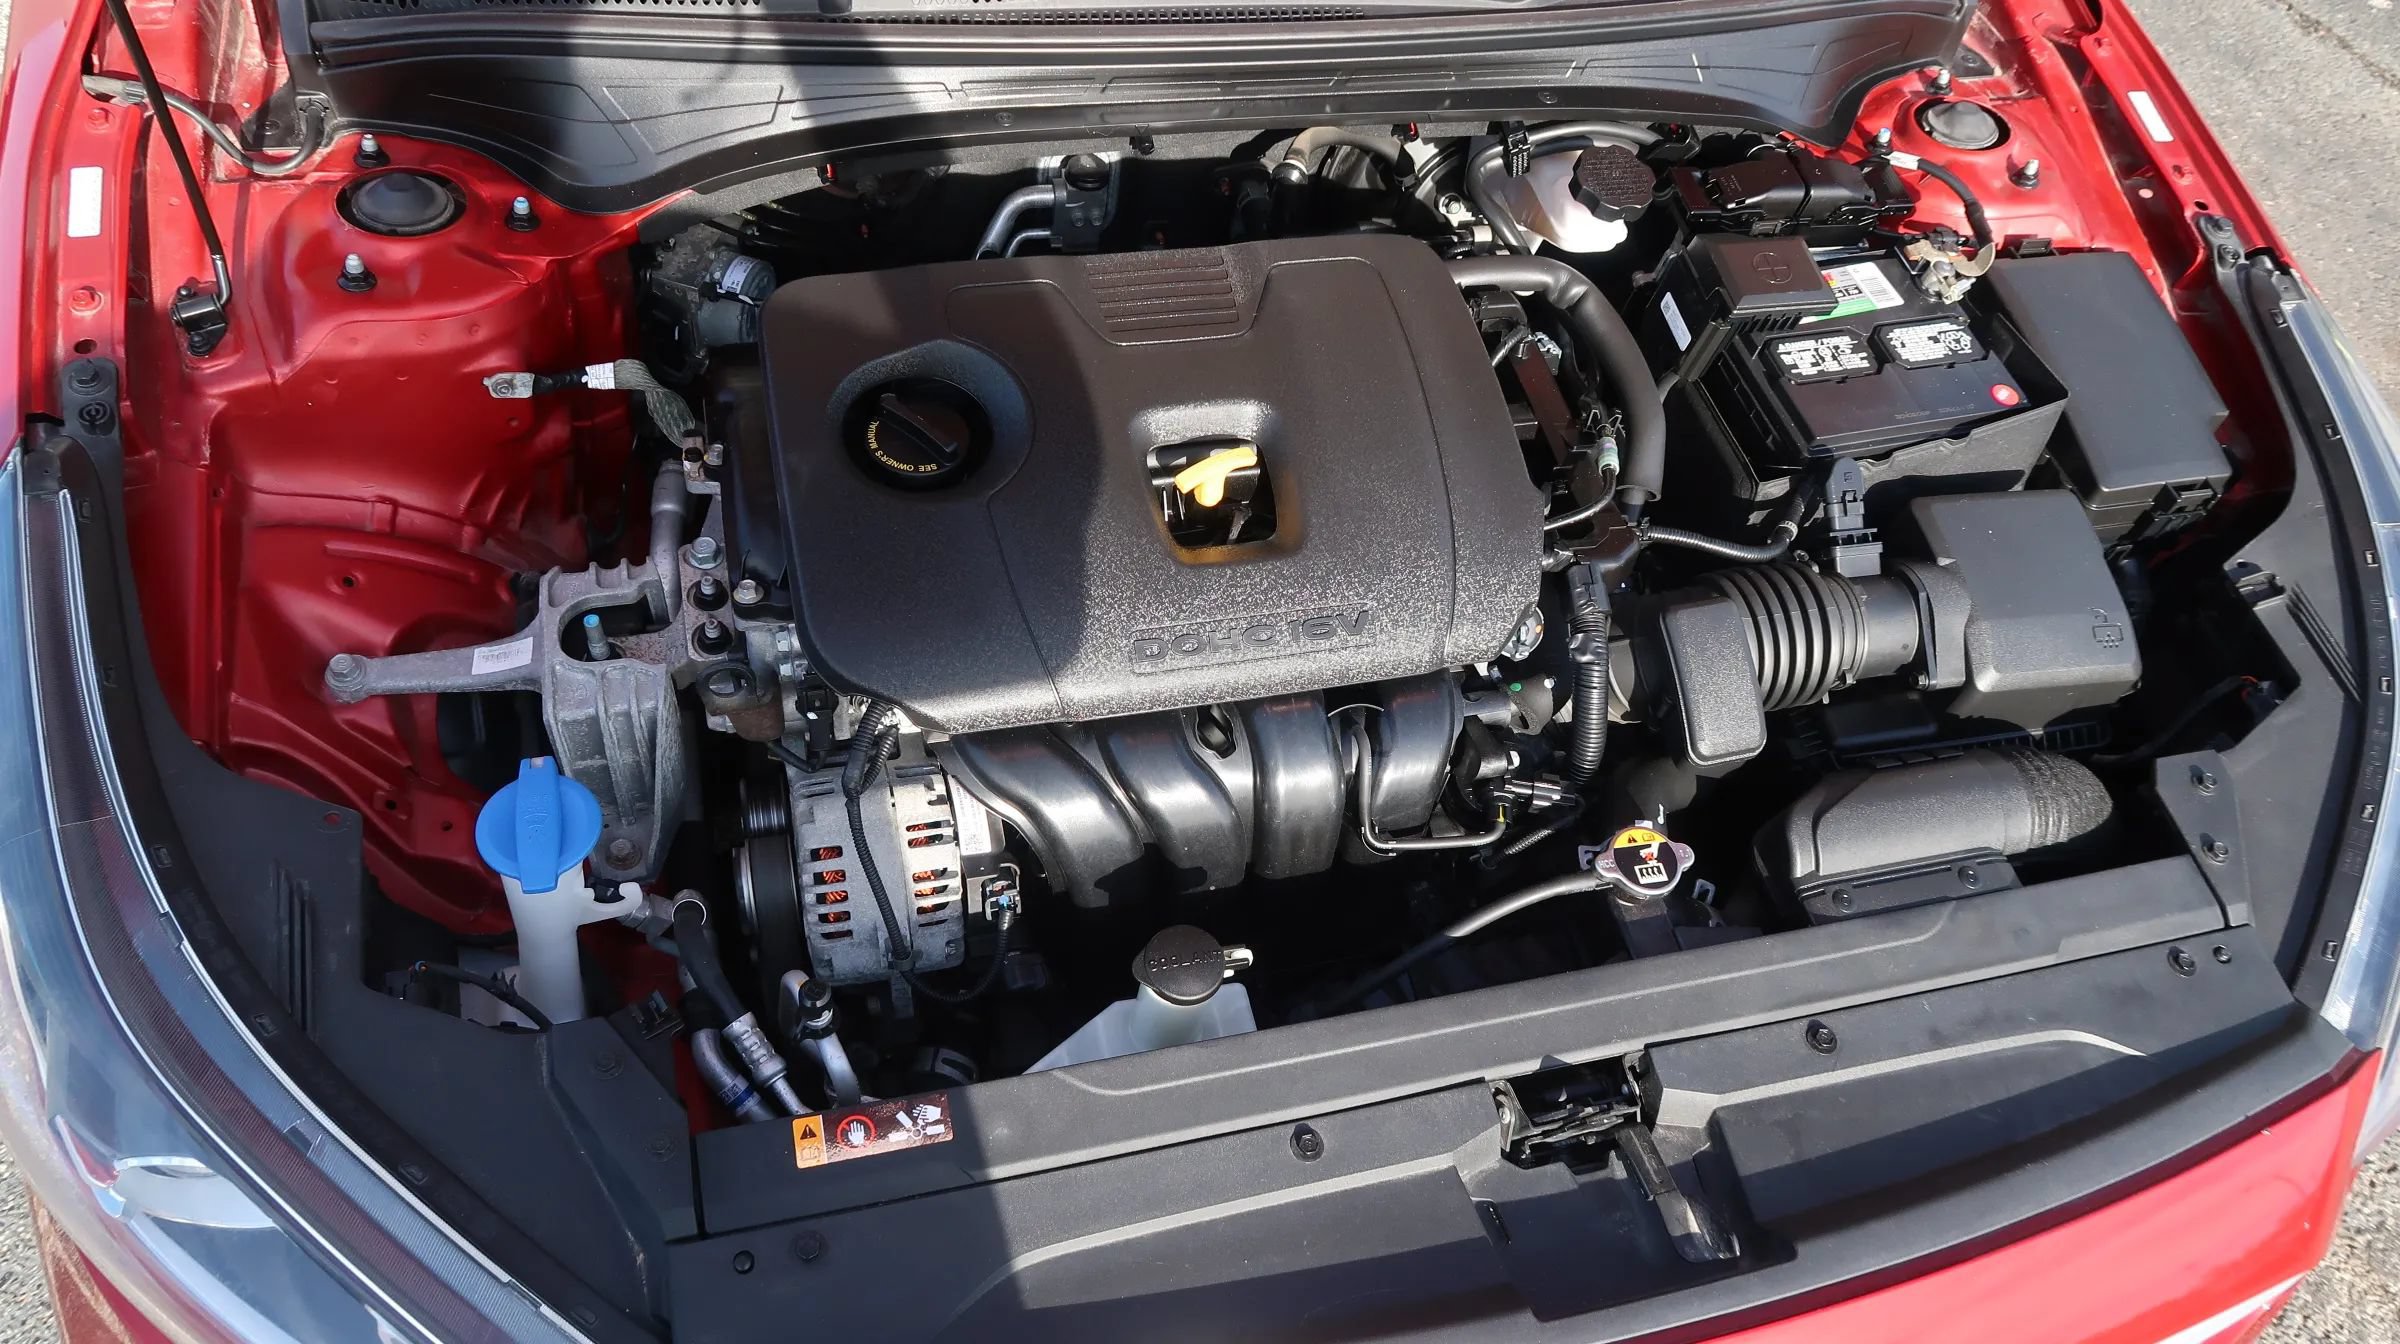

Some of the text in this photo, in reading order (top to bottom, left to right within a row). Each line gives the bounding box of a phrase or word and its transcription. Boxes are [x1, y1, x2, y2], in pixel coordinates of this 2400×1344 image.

[867, 420, 938, 472] SEE OWNER'S MANUAL
[1133, 611, 1370, 662] DOHC 16V
[1149, 950, 1222, 973] COOLANT
